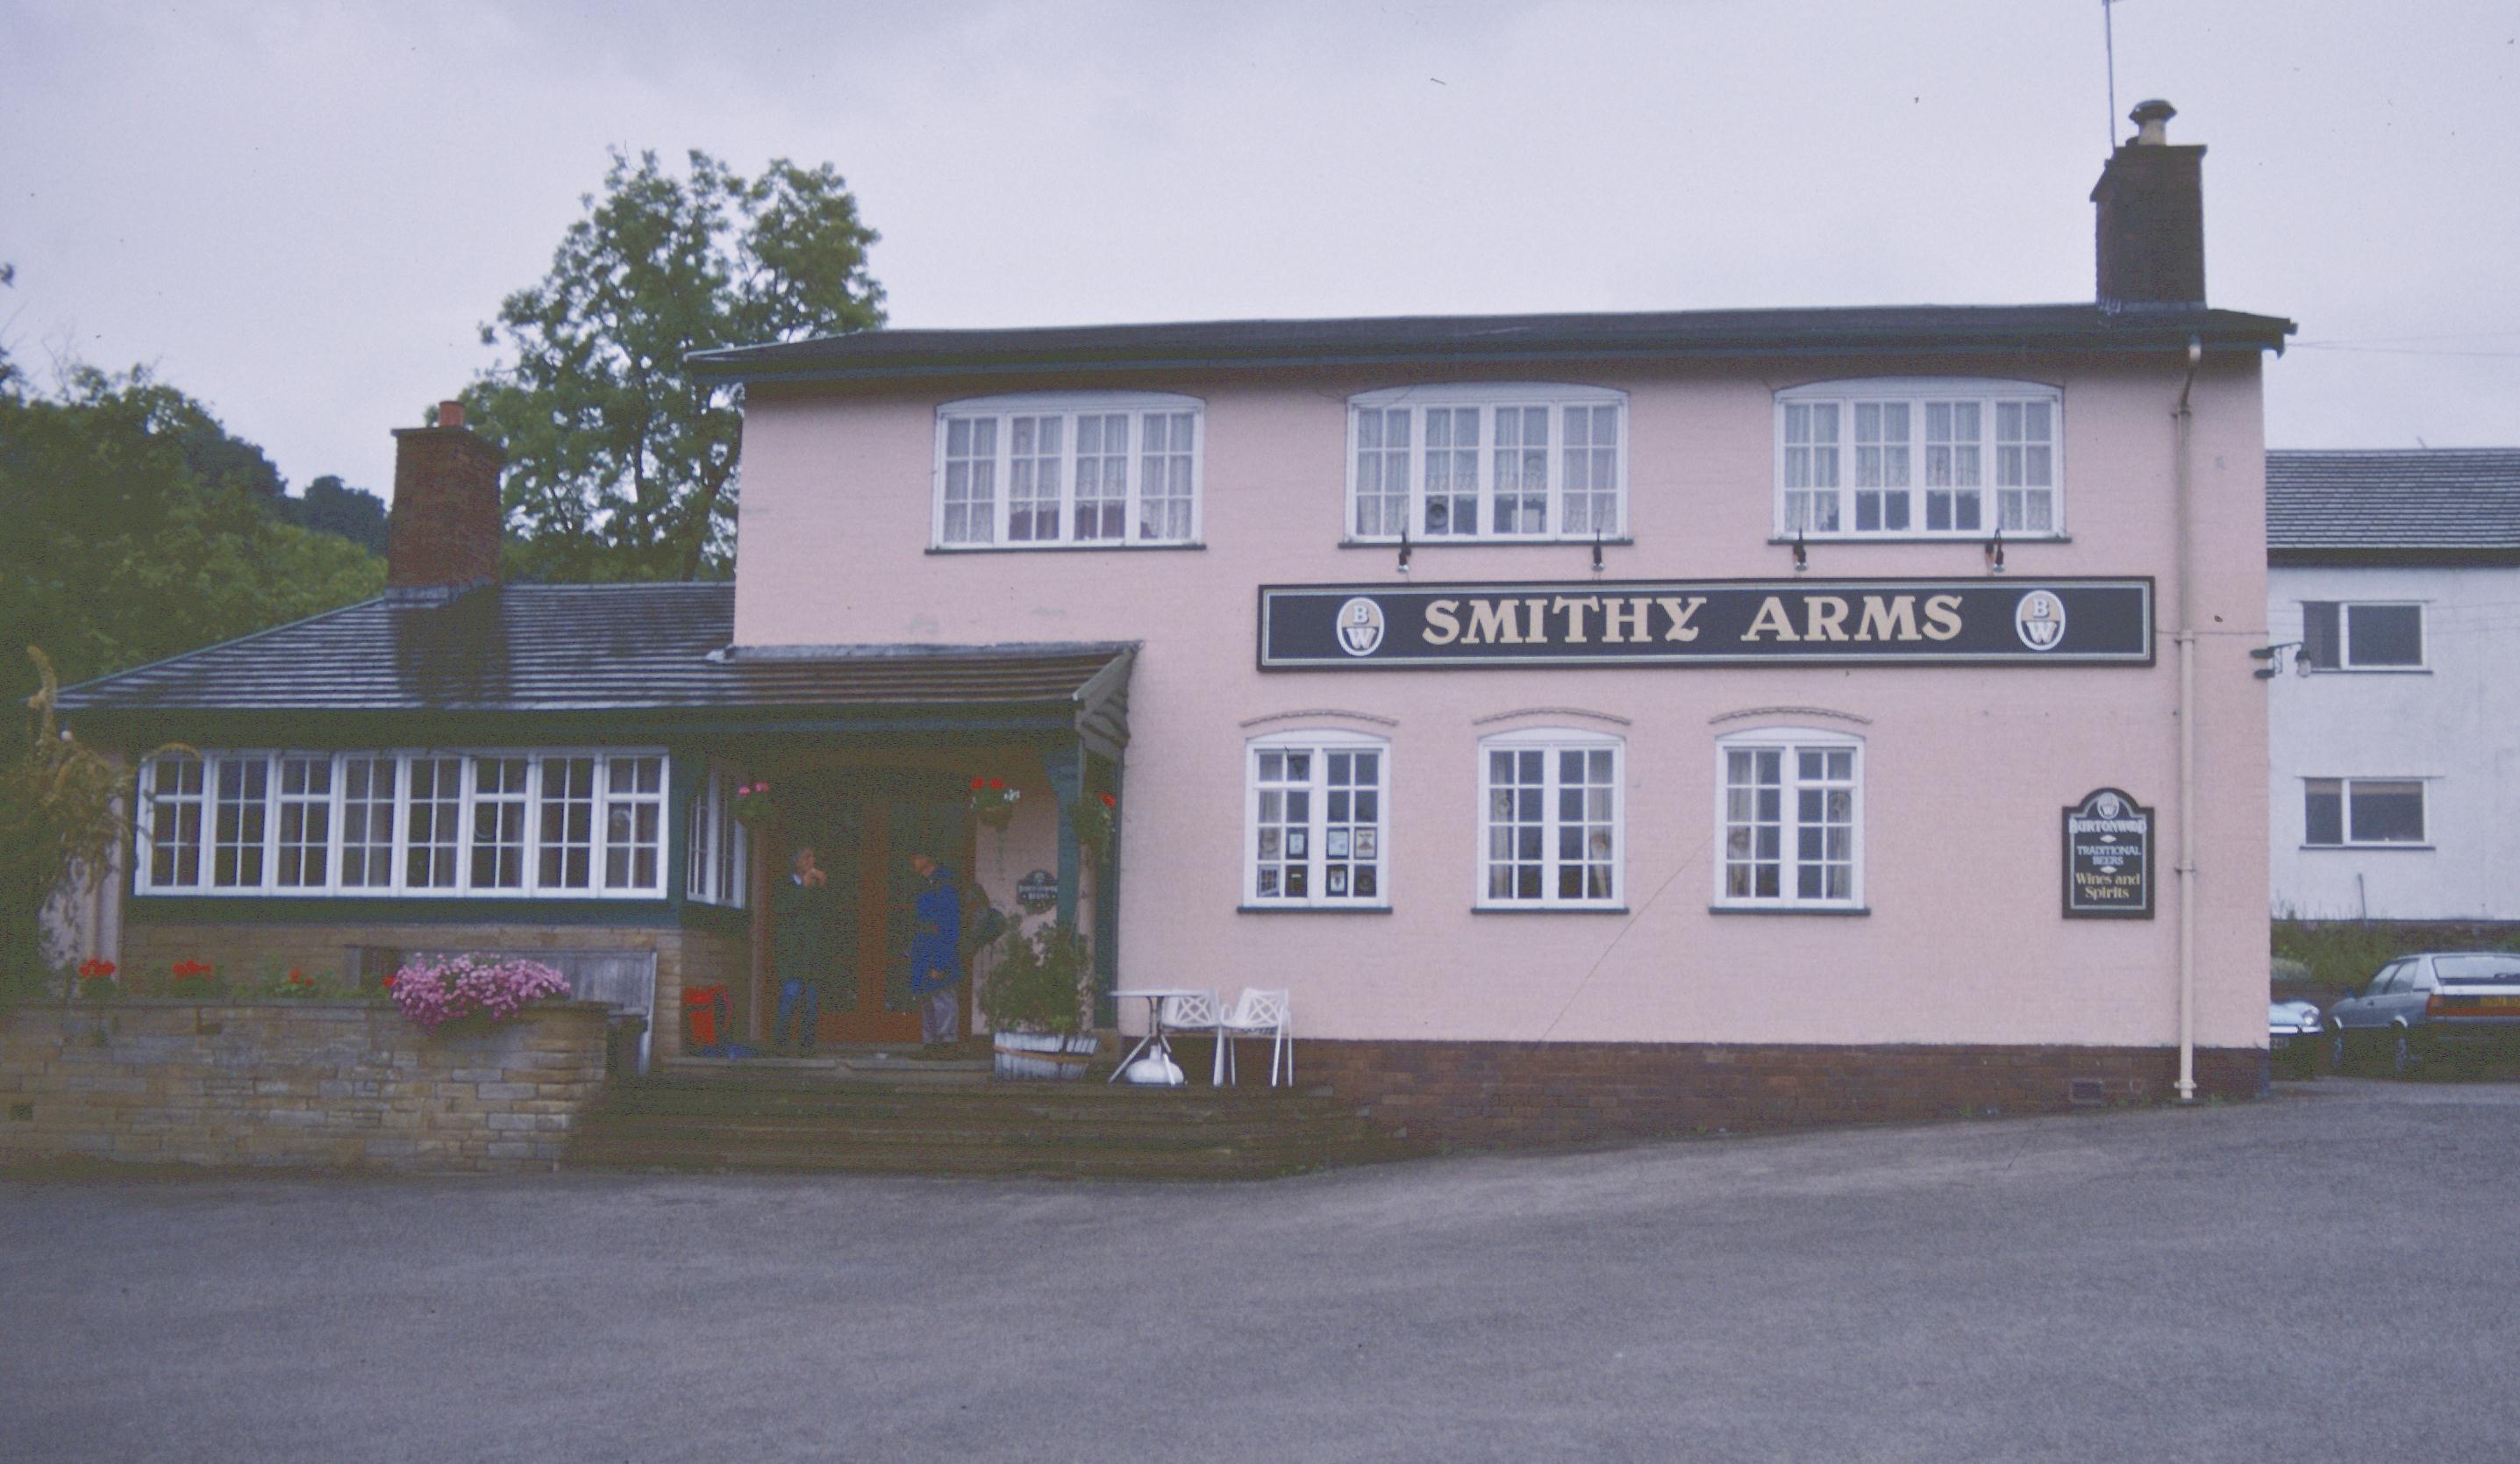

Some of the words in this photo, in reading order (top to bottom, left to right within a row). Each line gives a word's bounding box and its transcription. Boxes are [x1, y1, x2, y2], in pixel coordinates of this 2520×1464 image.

[1353, 604, 1369, 623] B
[2032, 597, 2050, 617] B
[1422, 596, 1707, 645] SMITHY
[1740, 595, 1963, 641] ARMS
[1347, 627, 1377, 649] W
[2025, 621, 2058, 644] W
[2076, 846, 2141, 856] TRADITIONAL
[2092, 856, 2124, 866] BEERS
[2075, 872, 2112, 885] Wines
[2115, 873, 2140, 885] and
[2085, 886, 2130, 901] Spirits
